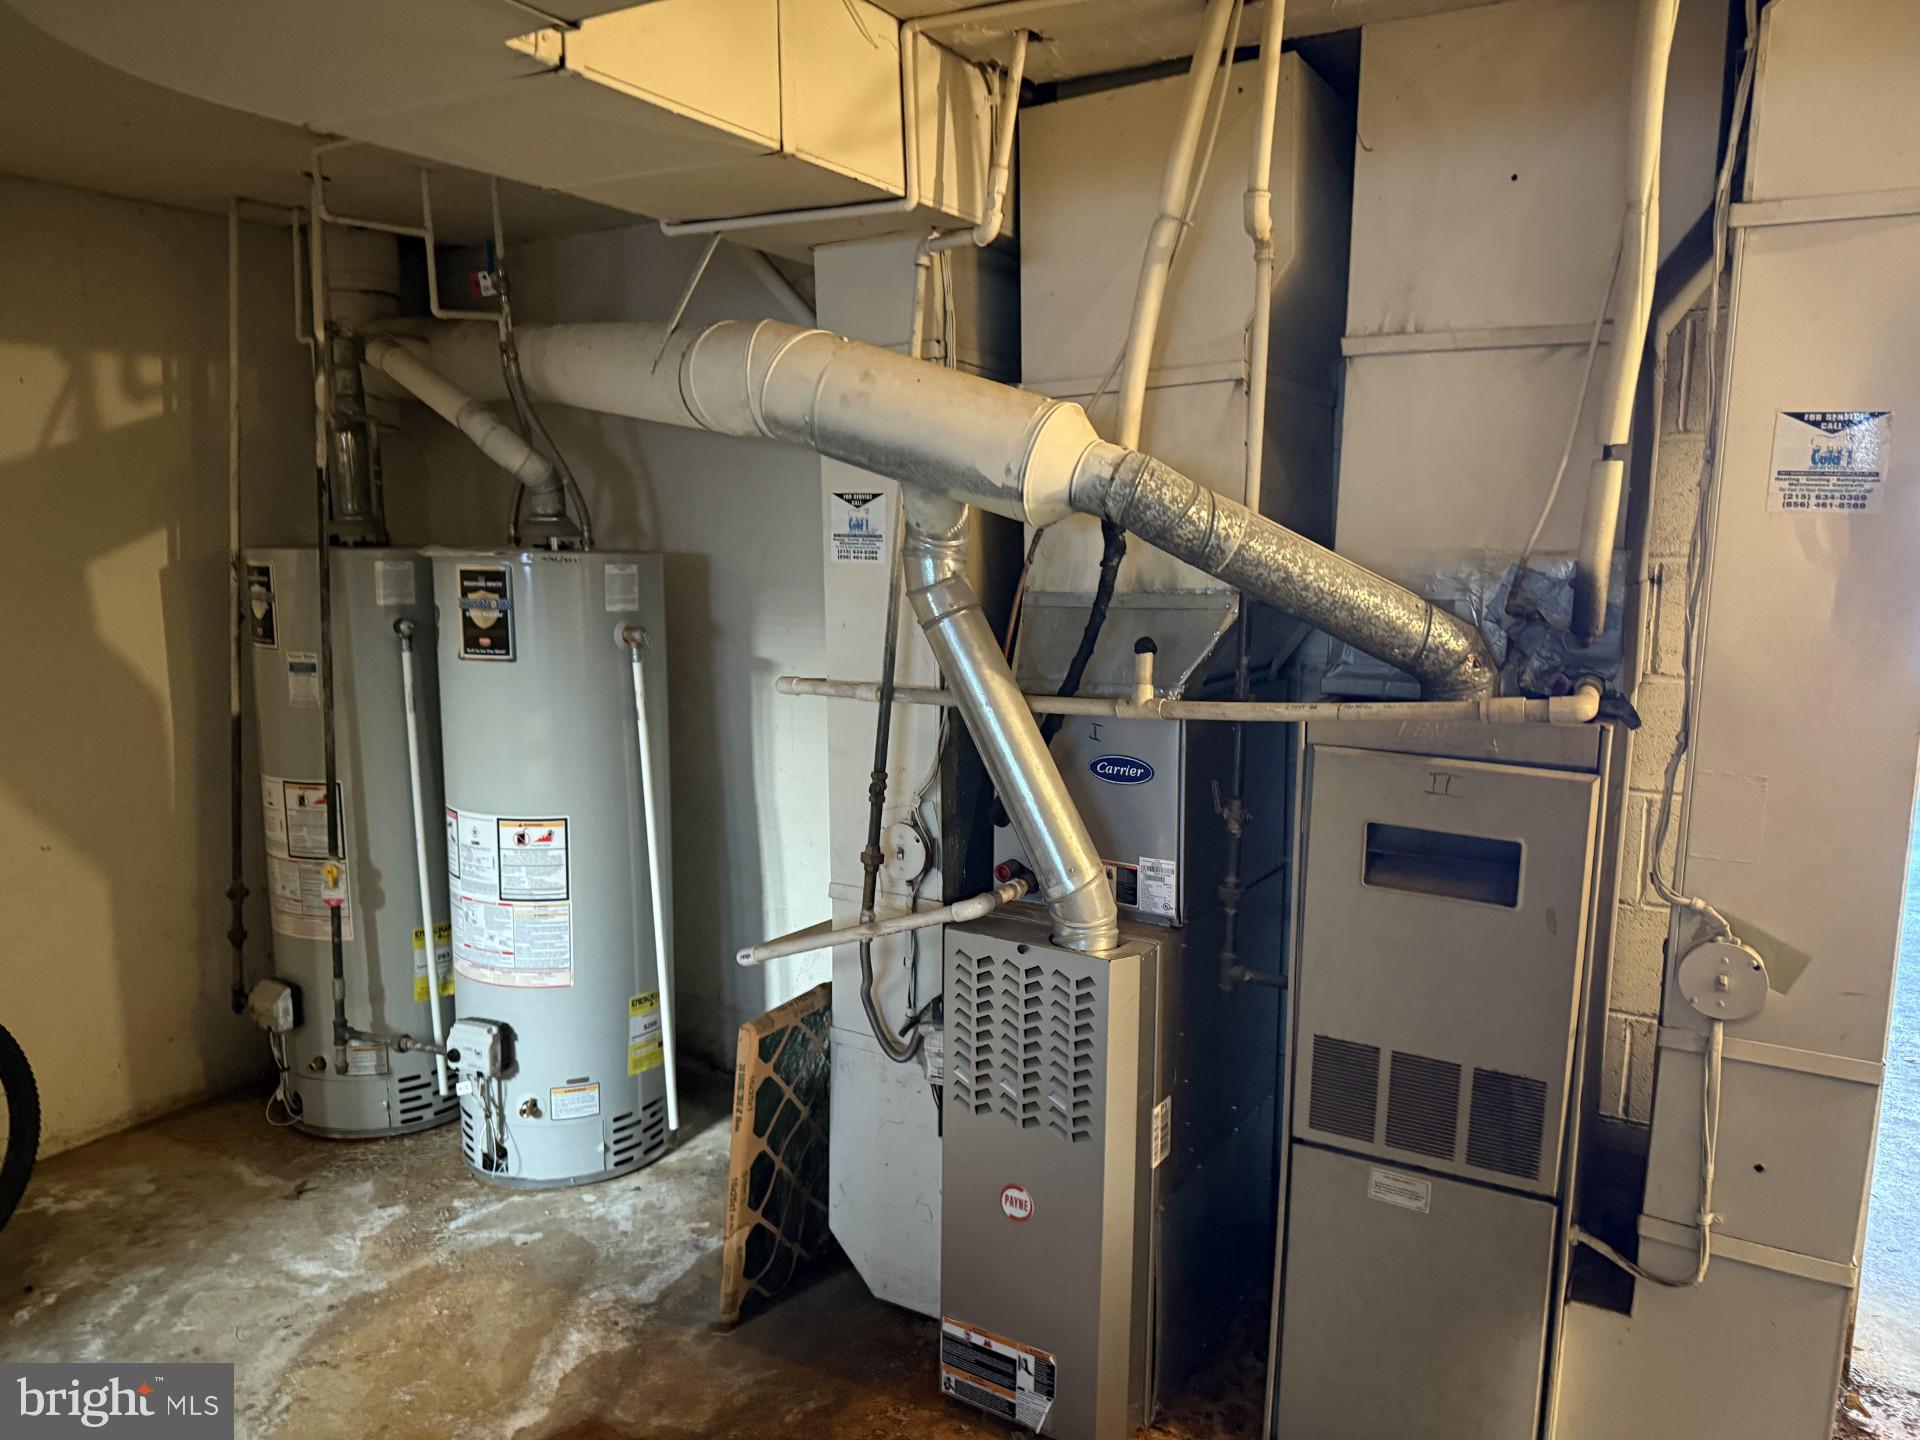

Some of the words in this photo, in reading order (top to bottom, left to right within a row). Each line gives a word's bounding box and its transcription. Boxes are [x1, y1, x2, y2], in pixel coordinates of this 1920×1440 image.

[1811, 447, 1843, 466] Cold
[1783, 493, 1811, 501] (215)
[1096, 761, 1145, 778] Carrier
[1004, 1194, 1029, 1212] PAYNE
